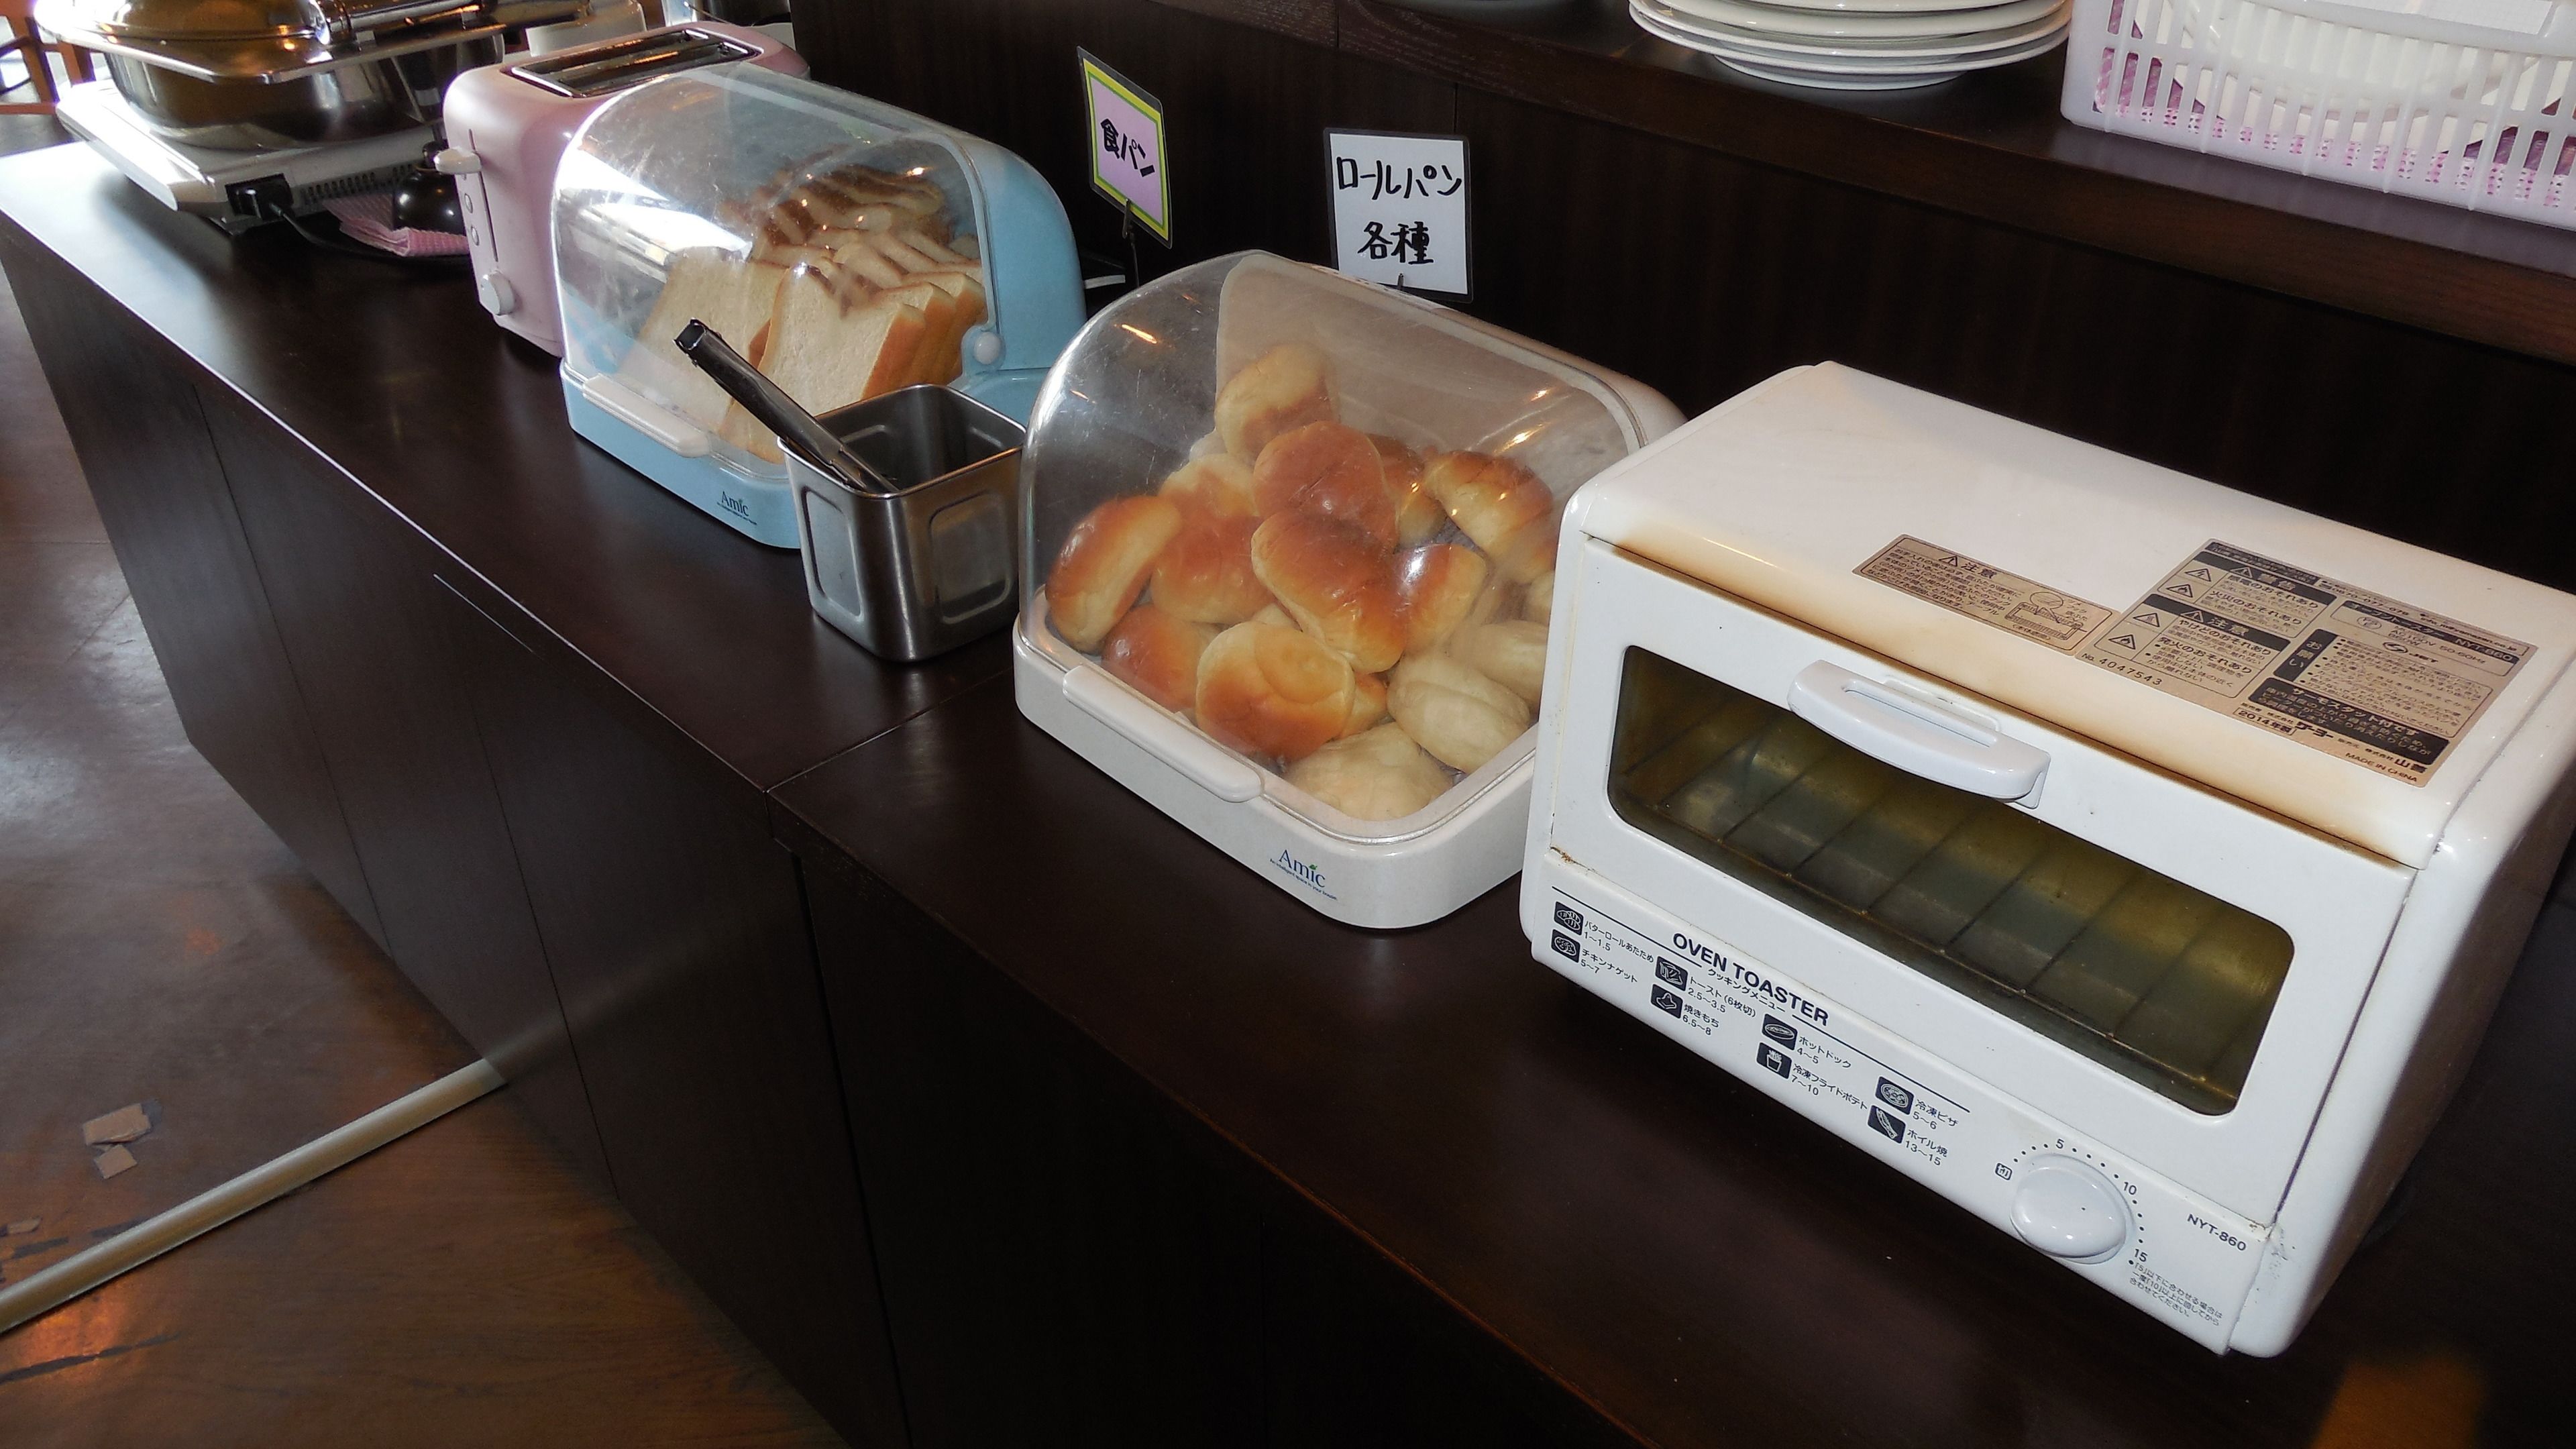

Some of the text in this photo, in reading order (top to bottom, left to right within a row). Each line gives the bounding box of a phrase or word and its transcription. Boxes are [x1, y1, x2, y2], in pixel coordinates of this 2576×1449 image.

[1101, 117, 1155, 177] 食パン
[1336, 156, 1462, 201] ロールパン
[1357, 221, 1434, 266] 各種
[721, 491, 749, 517] Amic
[1959, 561, 1998, 579] 注意
[2157, 636, 2254, 674] 発火のおそれあり
[2177, 619, 2272, 655] やけどのおそれあり
[2097, 657, 2164, 685] 4047543
[2290, 688, 2419, 737] サーモスタット付です
[2345, 752, 2375, 765] MADE
[1279, 849, 1326, 888] Amic
[1584, 920, 1655, 964] バターロールあたため
[1580, 947, 1640, 985] チキンナゲット
[1672, 932, 1829, 1027] OVEN TOASTER
[1707, 967, 1786, 1014] クッキングメニュー
[1682, 1003, 1721, 1028] 焼きもち
[1905, 1128, 1950, 1158] ホイル焼
[2056, 1138, 2064, 1150] 5
[2123, 1181, 2137, 1195] 10
[2187, 1213, 2247, 1252] NYT-860
[2134, 1248, 2149, 1263] 15
